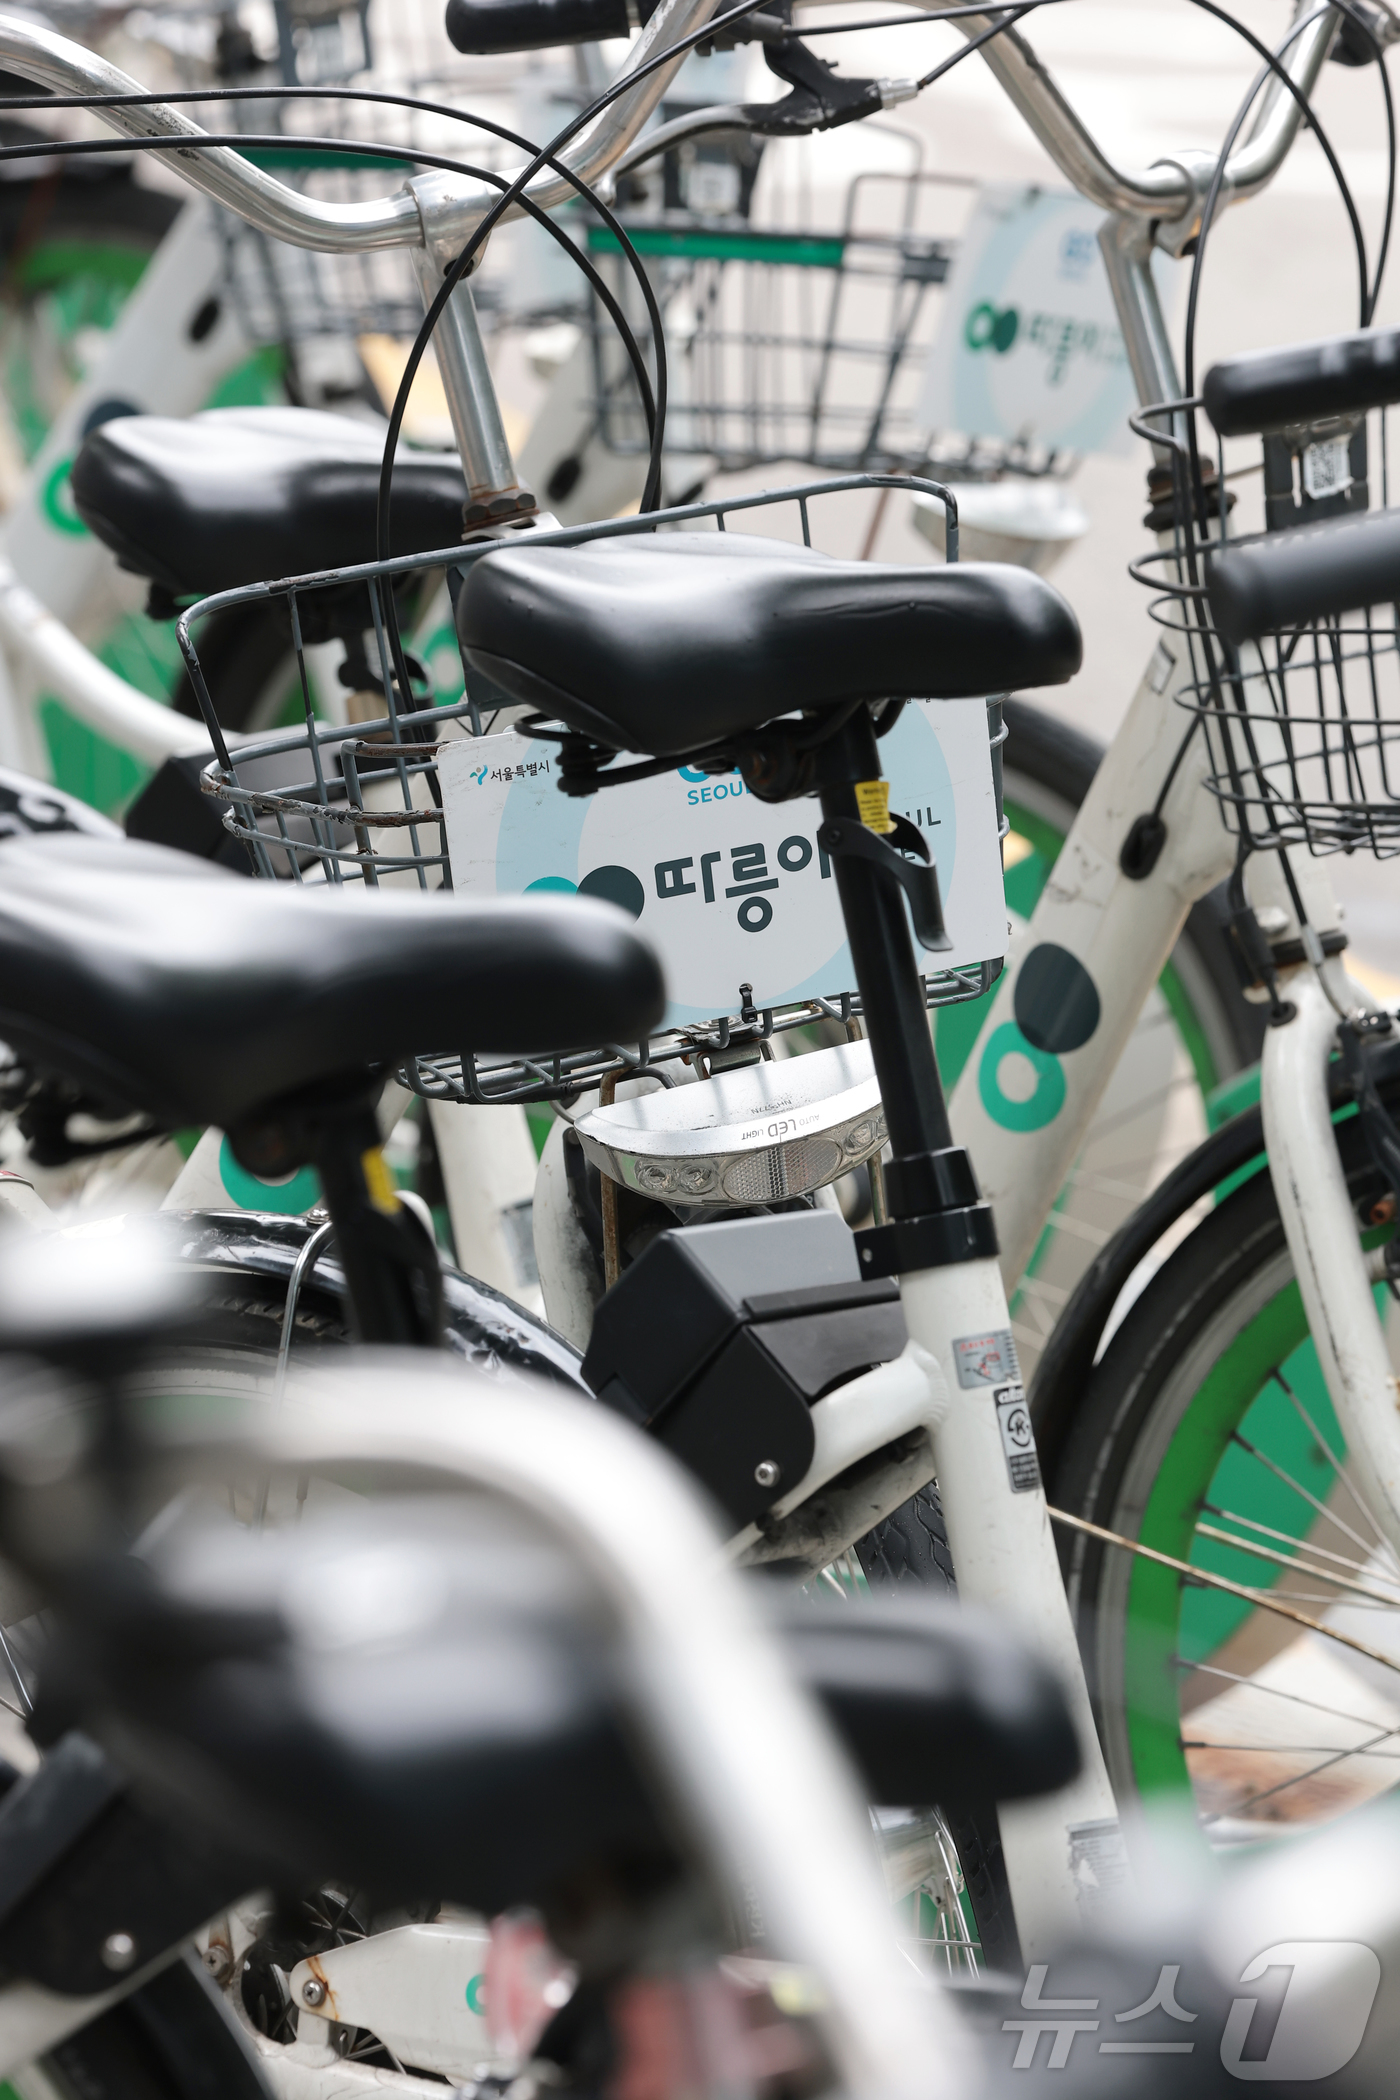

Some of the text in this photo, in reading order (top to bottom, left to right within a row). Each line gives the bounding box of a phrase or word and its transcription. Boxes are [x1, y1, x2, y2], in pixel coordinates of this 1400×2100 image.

[490, 760, 550, 782] 서울특별시
[654, 830, 832, 933] 따릉이
[741, 1114, 820, 1141] AUTO LED LIGHT
